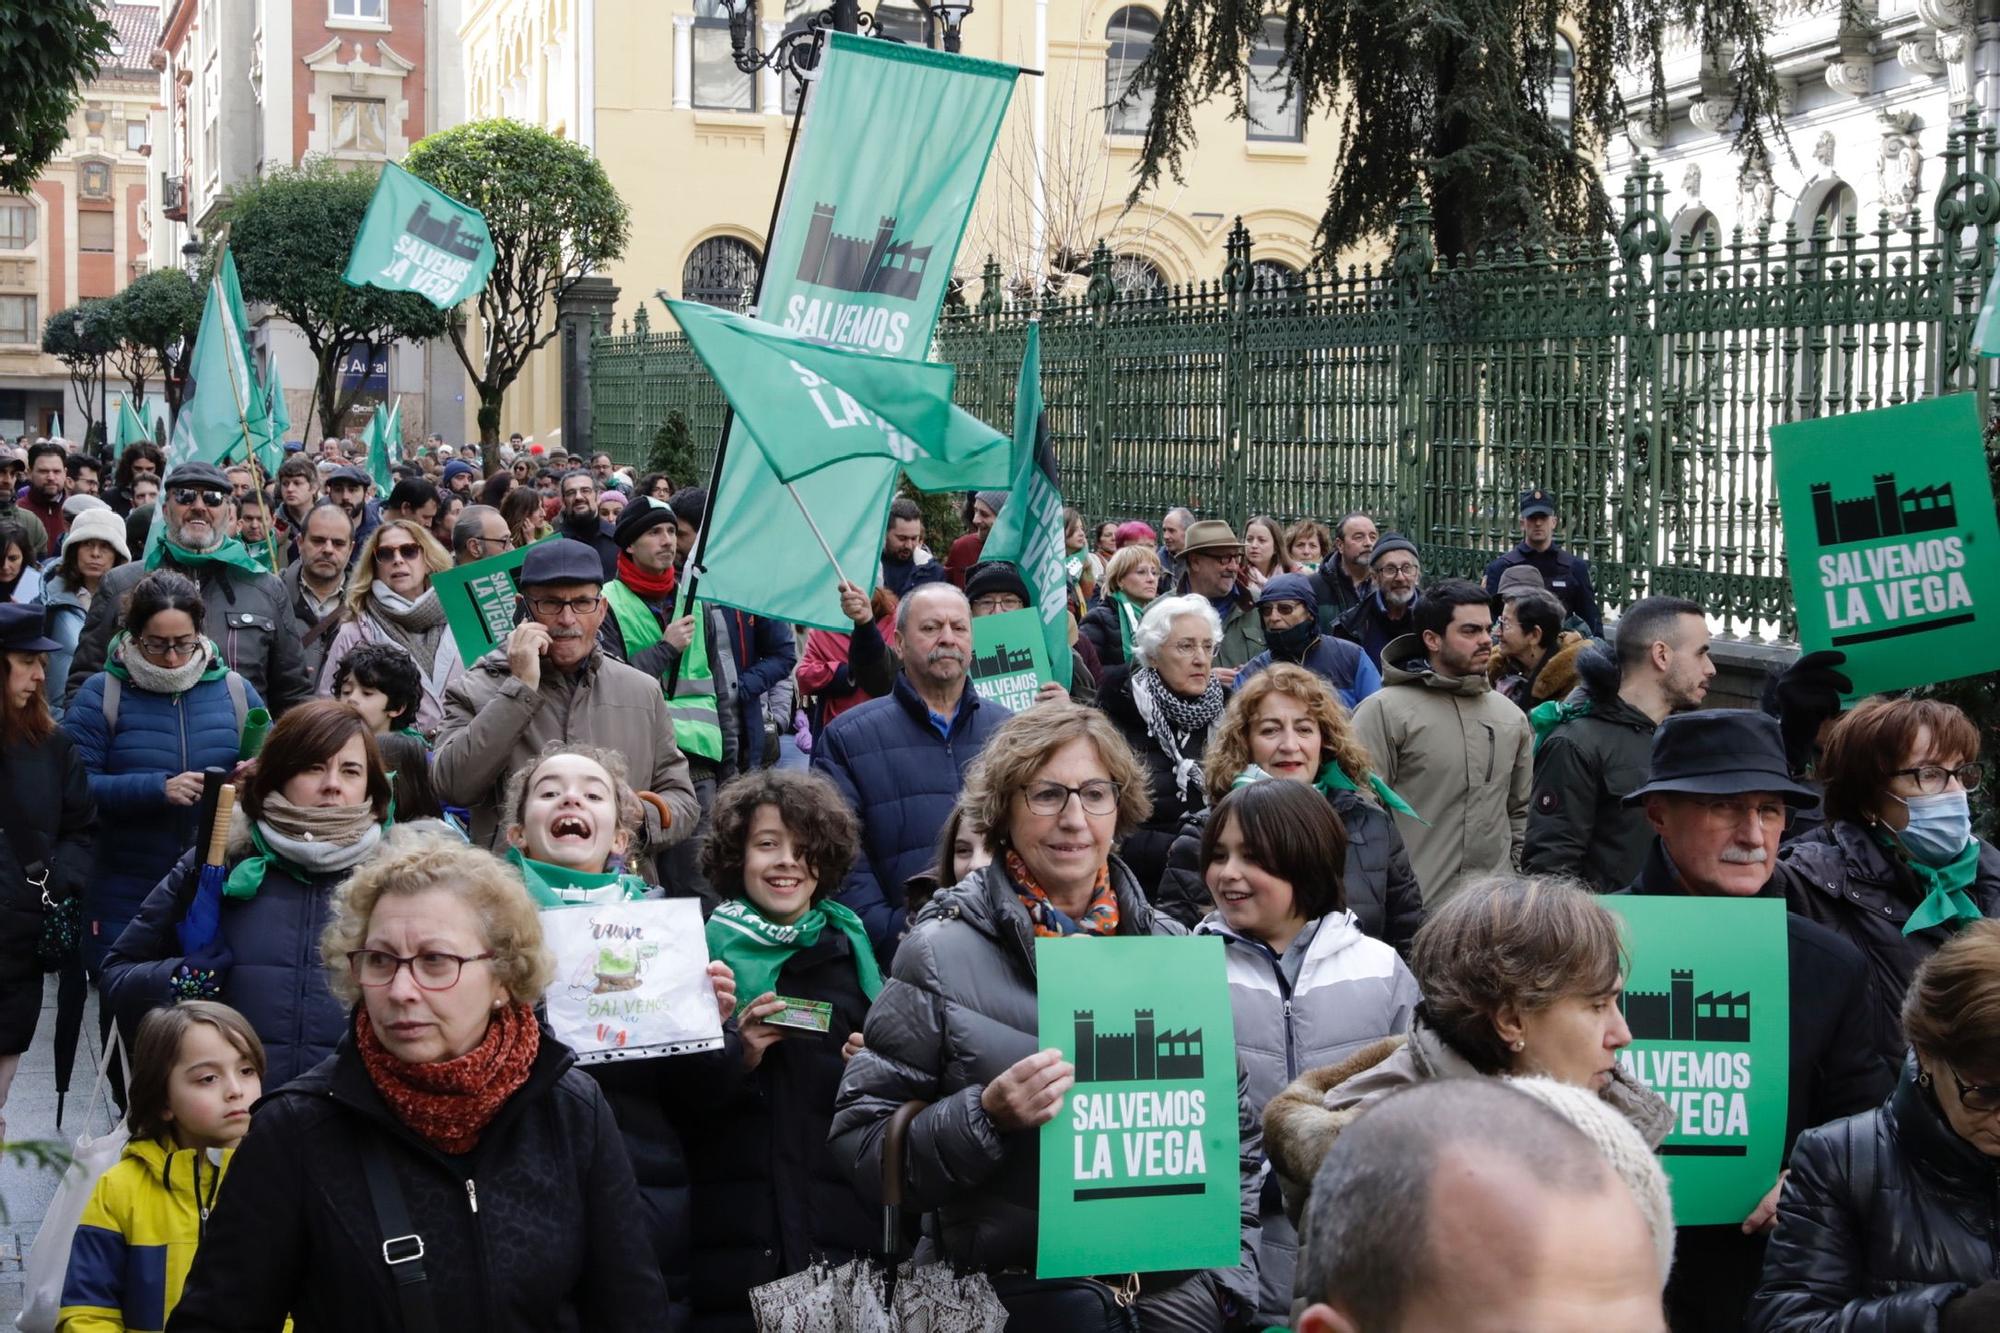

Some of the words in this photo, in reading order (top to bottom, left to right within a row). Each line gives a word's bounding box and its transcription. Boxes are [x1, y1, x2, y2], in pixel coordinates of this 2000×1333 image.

[380, 251, 412, 284] LA
[393, 234, 473, 284] SALVEMOS
[783, 294, 910, 353] SALVEMOS
[1020, 523, 1068, 626] VEGA
[1818, 536, 1966, 588] SALVEMOS
[471, 577, 494, 598] LA
[1824, 586, 1872, 630] LA
[1875, 571, 1974, 621] VEGA
[973, 672, 1039, 699] SALVEMOS
[1619, 1050, 1751, 1089] ALVEMOS
[1072, 1089, 1206, 1131] SALVEMOS
[1074, 1133, 1113, 1180] LA
[1122, 1130, 1207, 1177] VEGA
